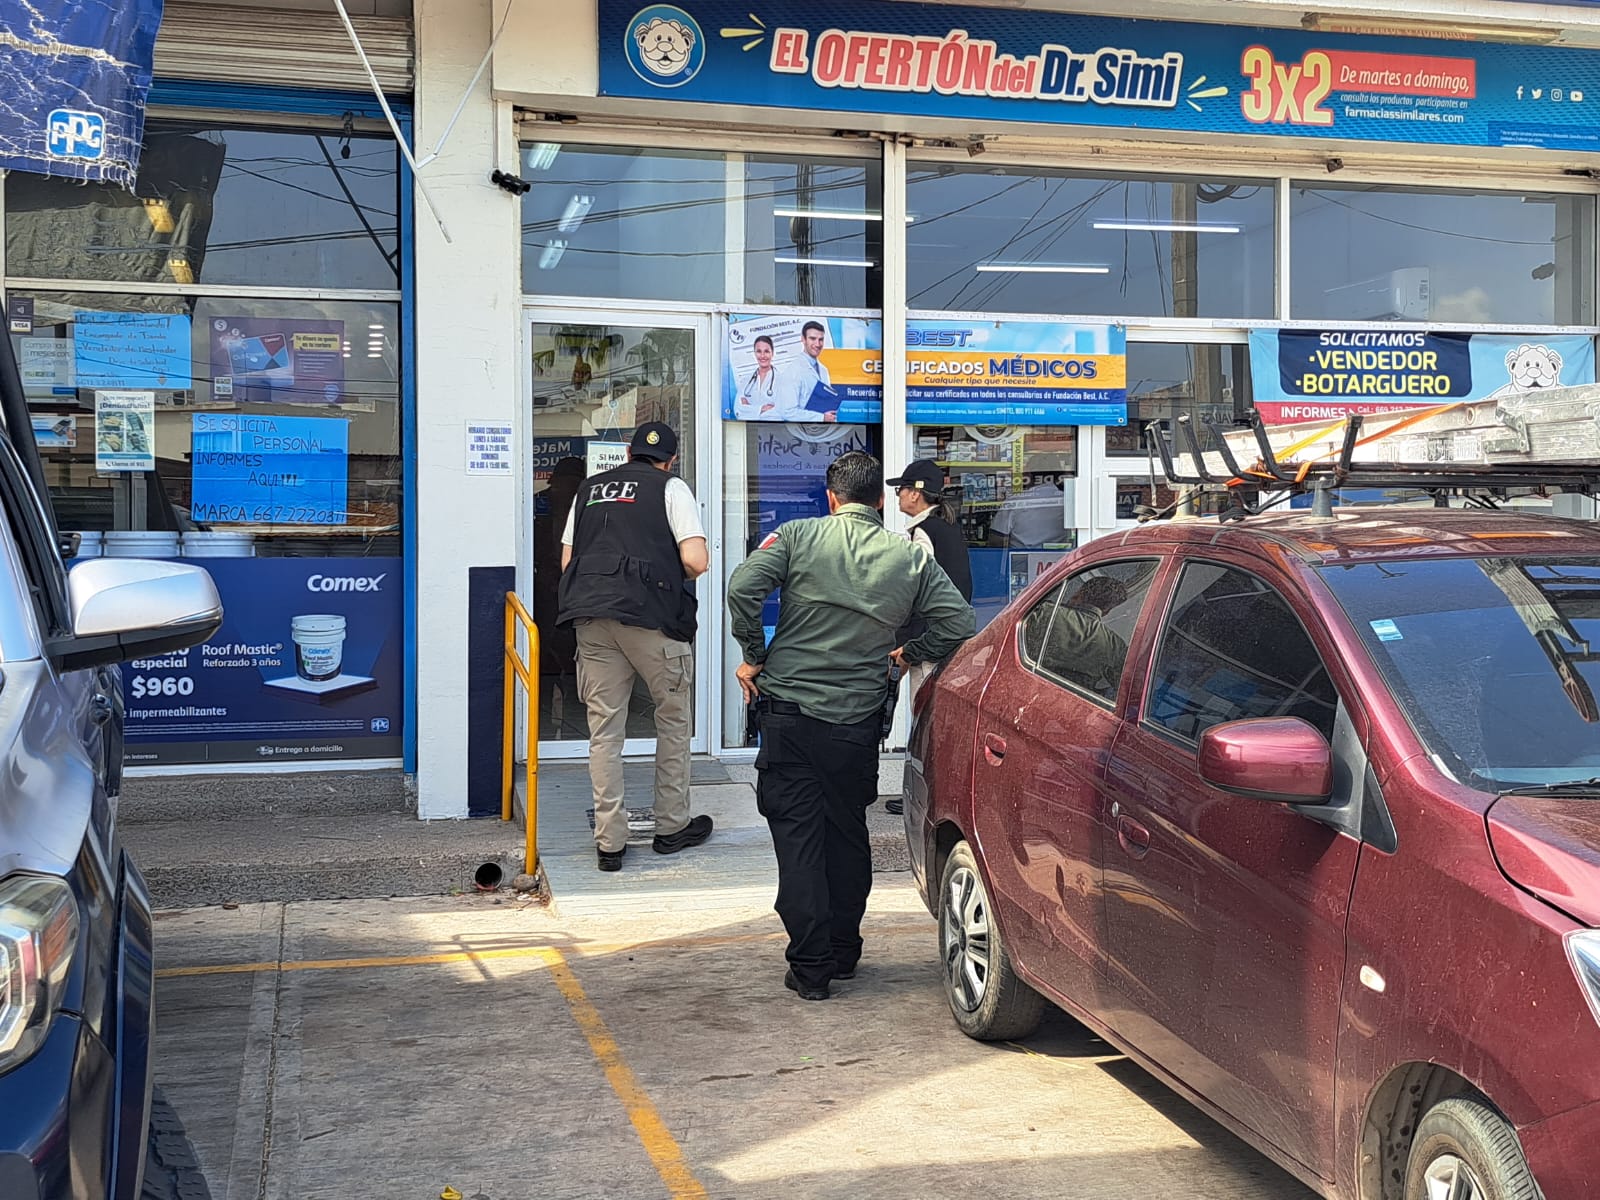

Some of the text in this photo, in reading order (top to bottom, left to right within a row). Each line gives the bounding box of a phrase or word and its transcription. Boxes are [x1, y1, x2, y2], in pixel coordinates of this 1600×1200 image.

[773, 31, 807, 70] EL
[815, 32, 993, 93] OFERTÓN
[991, 59, 1036, 94] del
[1339, 65, 1470, 94] De martes a domingo,
[1340, 92, 1369, 103] consulta
[1369, 93, 1380, 104] los
[1380, 94, 1413, 107] productos
[1415, 97, 1459, 109] participantes
[1344, 105, 1464, 123] farmaciassimilares.com
[50, 115, 102, 154] PPG
[1319, 332, 1426, 347] SOLICITAMOS
[988, 354, 1097, 379] MÉDICOS
[924, 376, 1037, 387] Cualquier tipo que necesite
[1281, 405, 1347, 419] INFORMES
[197, 414, 278, 433] SE SOLICITA
[253, 435, 328, 453] PERSONAL
[195, 448, 263, 467] INFORMES
[608, 454, 626, 462] HAY
[589, 481, 639, 502] FGE
[192, 502, 247, 521] MARCA
[306, 572, 387, 593] Comex
[202, 643, 232, 656] Roof
[131, 657, 187, 671] especial
[203, 658, 281, 668] Reforzado 3 años
[131, 675, 194, 699] $960
[129, 706, 227, 720] impermeabilizantes
[275, 746, 303, 755] Entrega
[310, 745, 343, 753] domicilio
